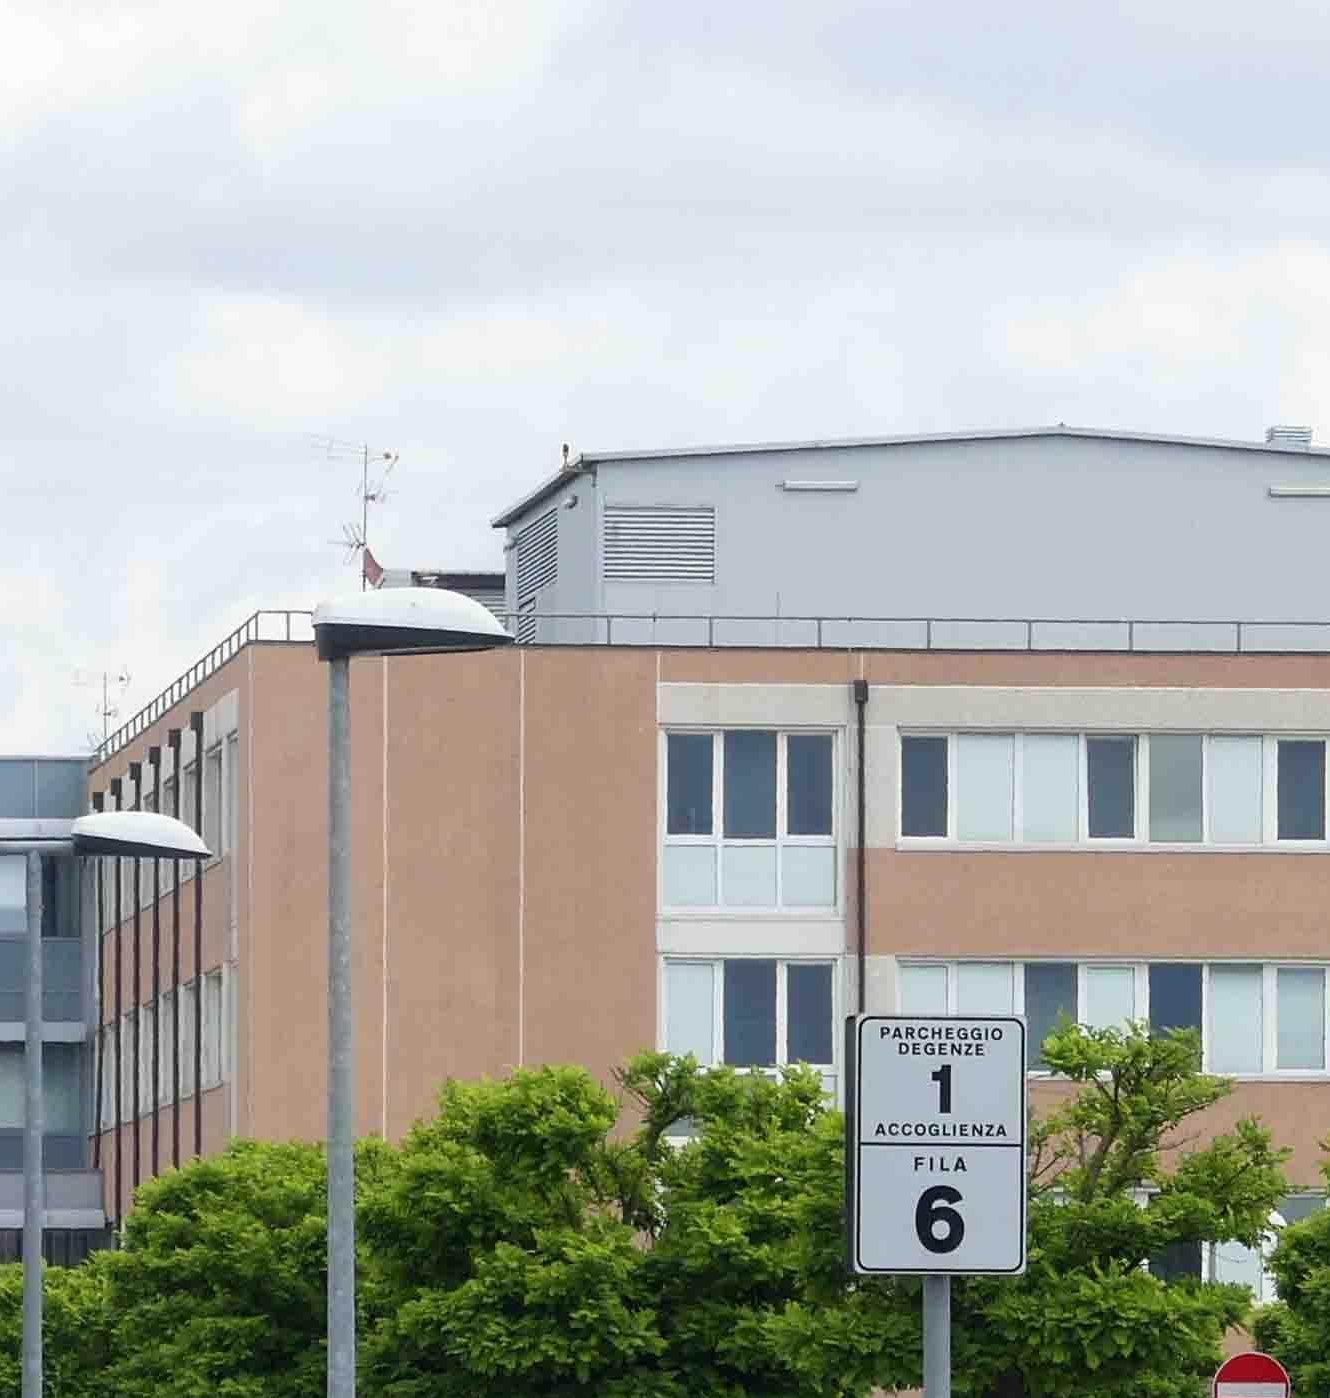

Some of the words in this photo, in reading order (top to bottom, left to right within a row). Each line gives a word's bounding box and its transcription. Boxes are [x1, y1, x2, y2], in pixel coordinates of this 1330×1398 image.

[880, 1026, 1003, 1041] PARCHEGGIO
[898, 1043, 985, 1056] DEGENZE
[931, 1064, 952, 1114] 1
[874, 1123, 1008, 1137] ACCOGLIENZA
[914, 1156, 968, 1172] FILA
[915, 1184, 965, 1254] 6
